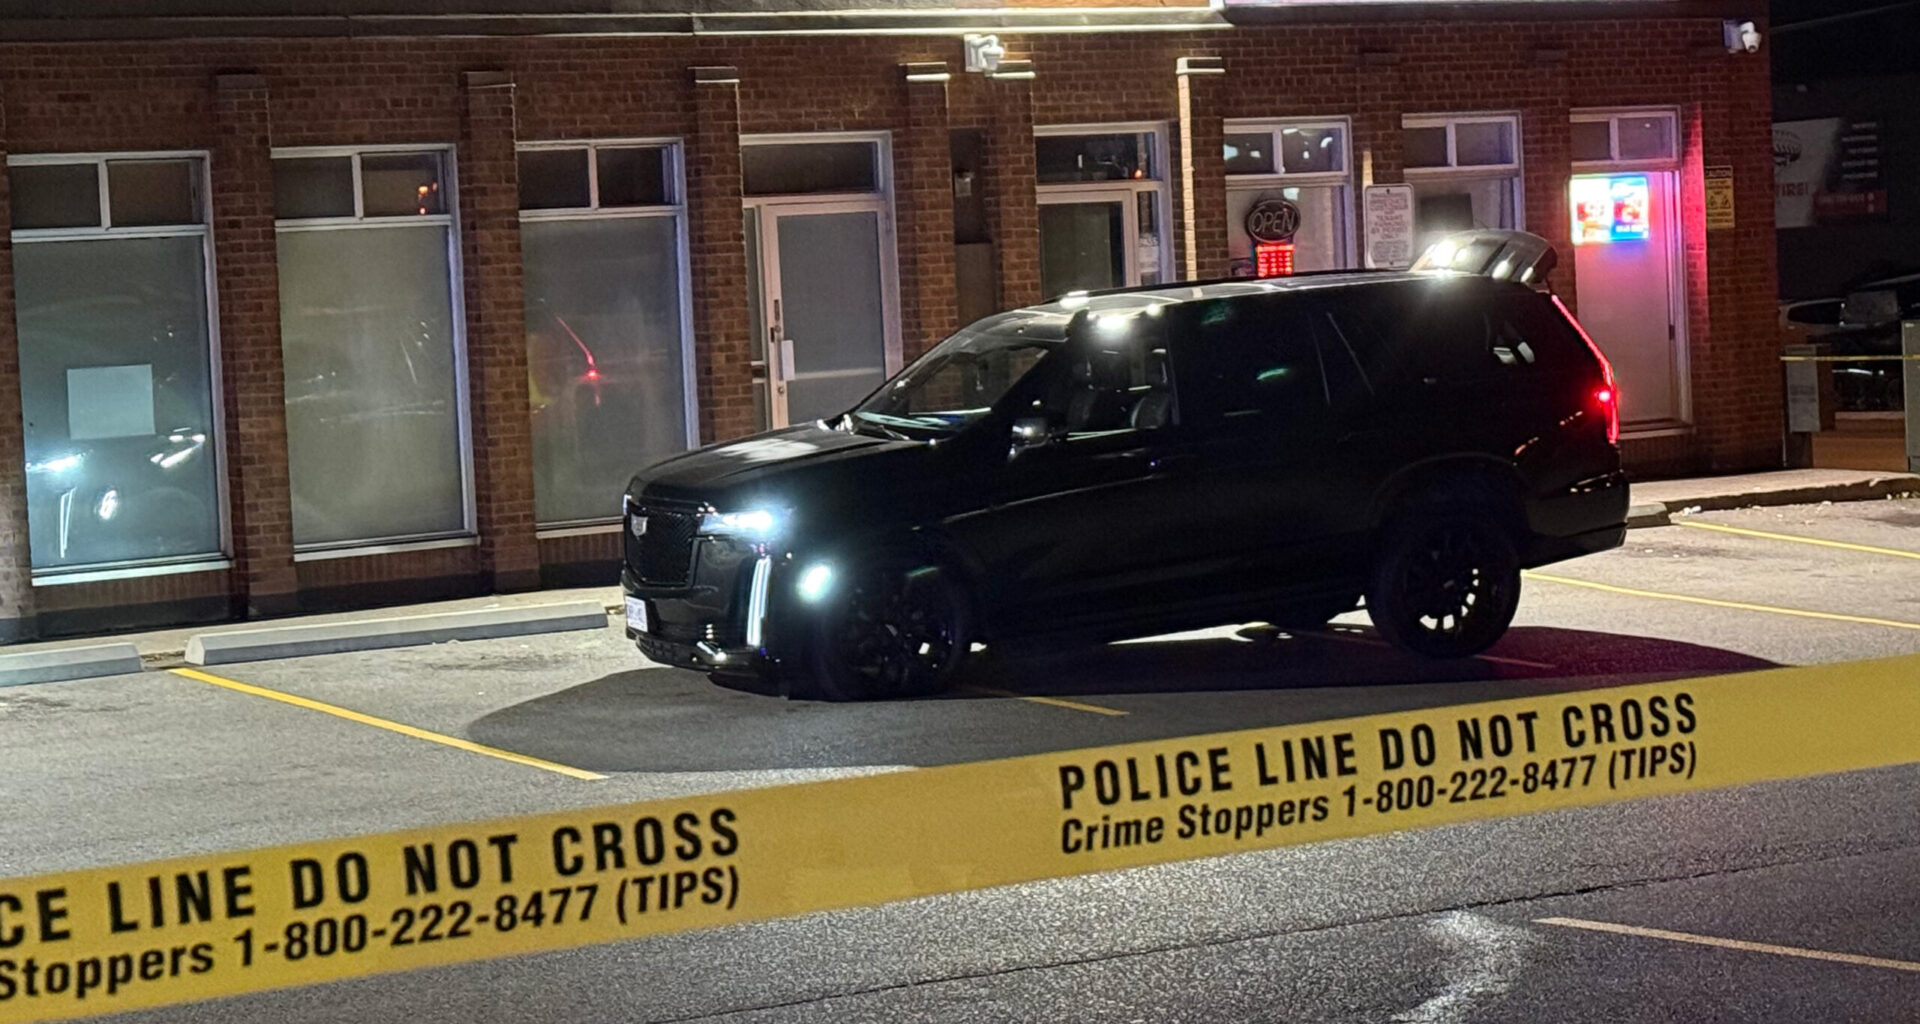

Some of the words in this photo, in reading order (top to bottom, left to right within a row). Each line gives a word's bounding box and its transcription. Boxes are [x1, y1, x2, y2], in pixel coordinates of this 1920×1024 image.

[1252, 210, 1295, 233] OPEN
[1059, 745, 1232, 809] POLICE
[1256, 731, 1357, 786] LINE
[1380, 723, 1436, 770] DO
[1458, 711, 1539, 761] NOT
[1562, 692, 1697, 748] CROSS
[1061, 804, 1164, 854] Crime
[1177, 788, 1329, 840] Stoppers
[1343, 754, 1597, 817] 1-800-222-8477
[1608, 741, 1697, 790] (TIPS)
[0, 886, 70, 949] CE
[108, 865, 256, 934] LINE
[291, 851, 370, 910] DO
[404, 833, 520, 896] NOT
[552, 807, 739, 877] CROSS
[0, 942, 213, 1001] Stoppers
[232, 884, 599, 968] 1-800-222-8477
[616, 865, 740, 925] (TIPS)
